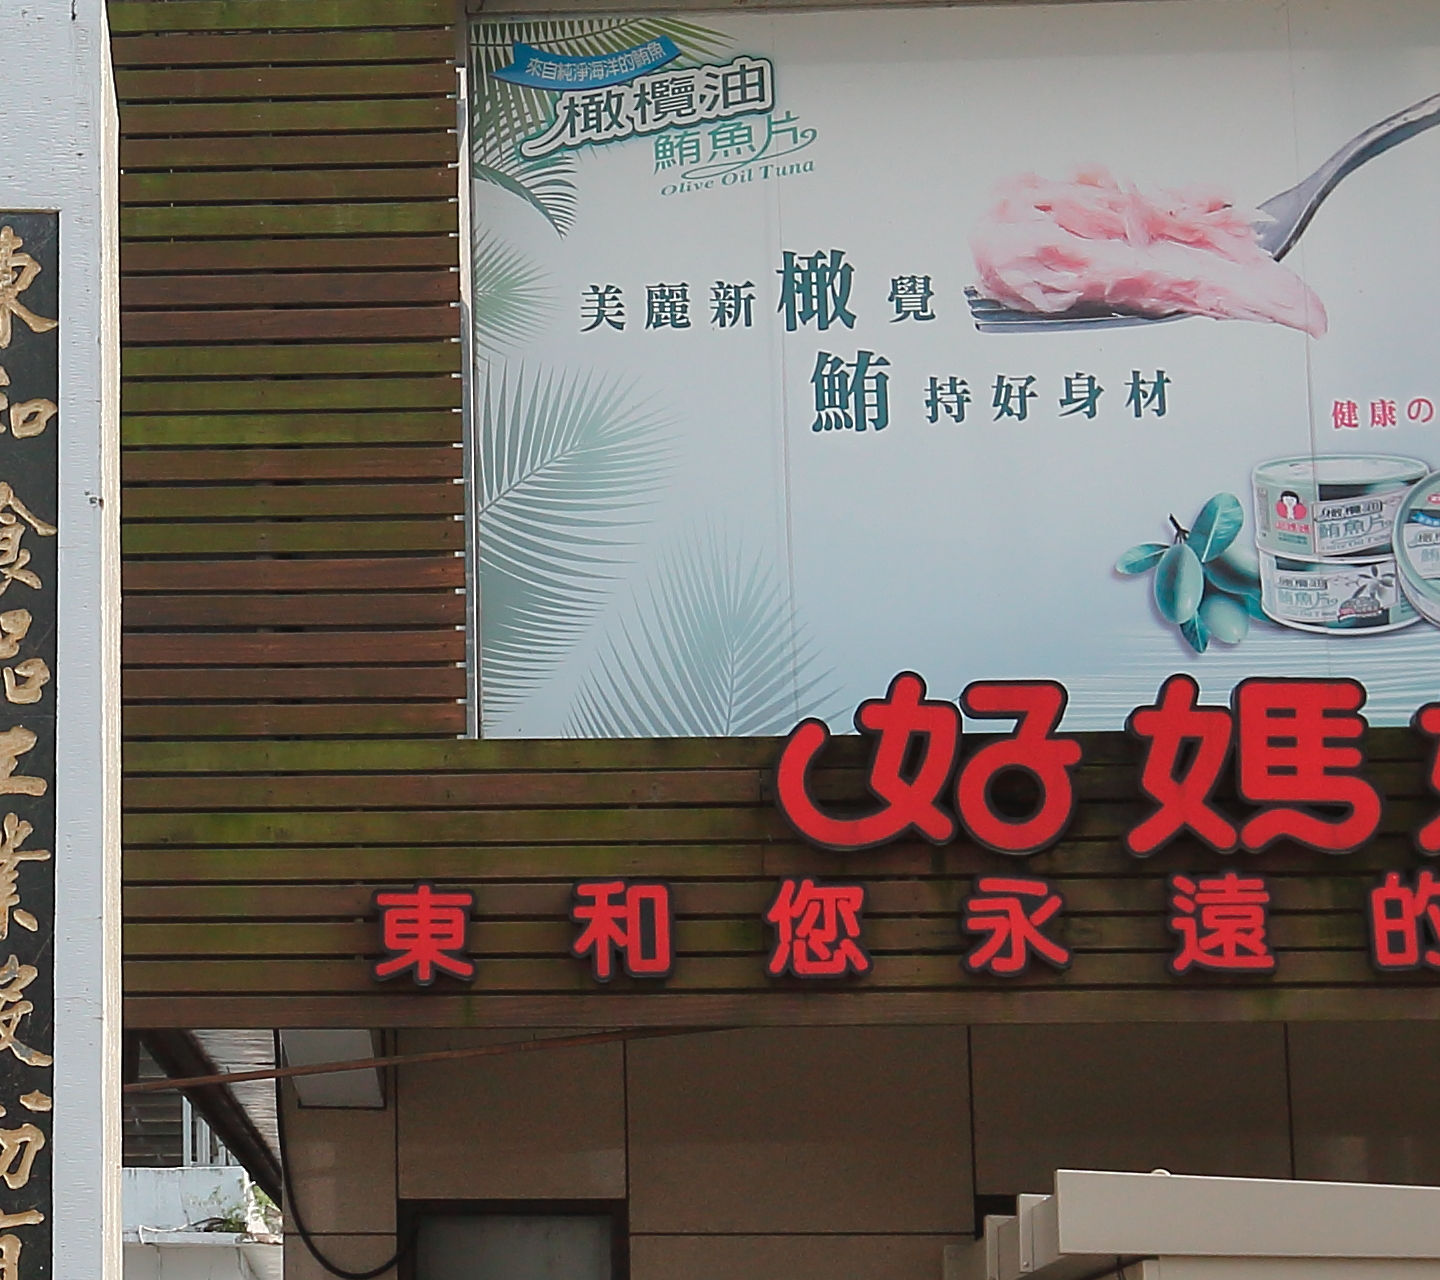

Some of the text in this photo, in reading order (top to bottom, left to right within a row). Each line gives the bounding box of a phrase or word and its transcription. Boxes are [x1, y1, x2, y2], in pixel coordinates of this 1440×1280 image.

[525, 41, 667, 84] 來自純淨海洋的鮪魚
[523, 60, 772, 157] 橄欖油
[653, 110, 817, 177] 鮪魚片
[661, 159, 816, 197] Olive Oil Tuna
[580, 249, 936, 332] 美麗新橄覺
[810, 351, 1171, 433] 鮪持好身材
